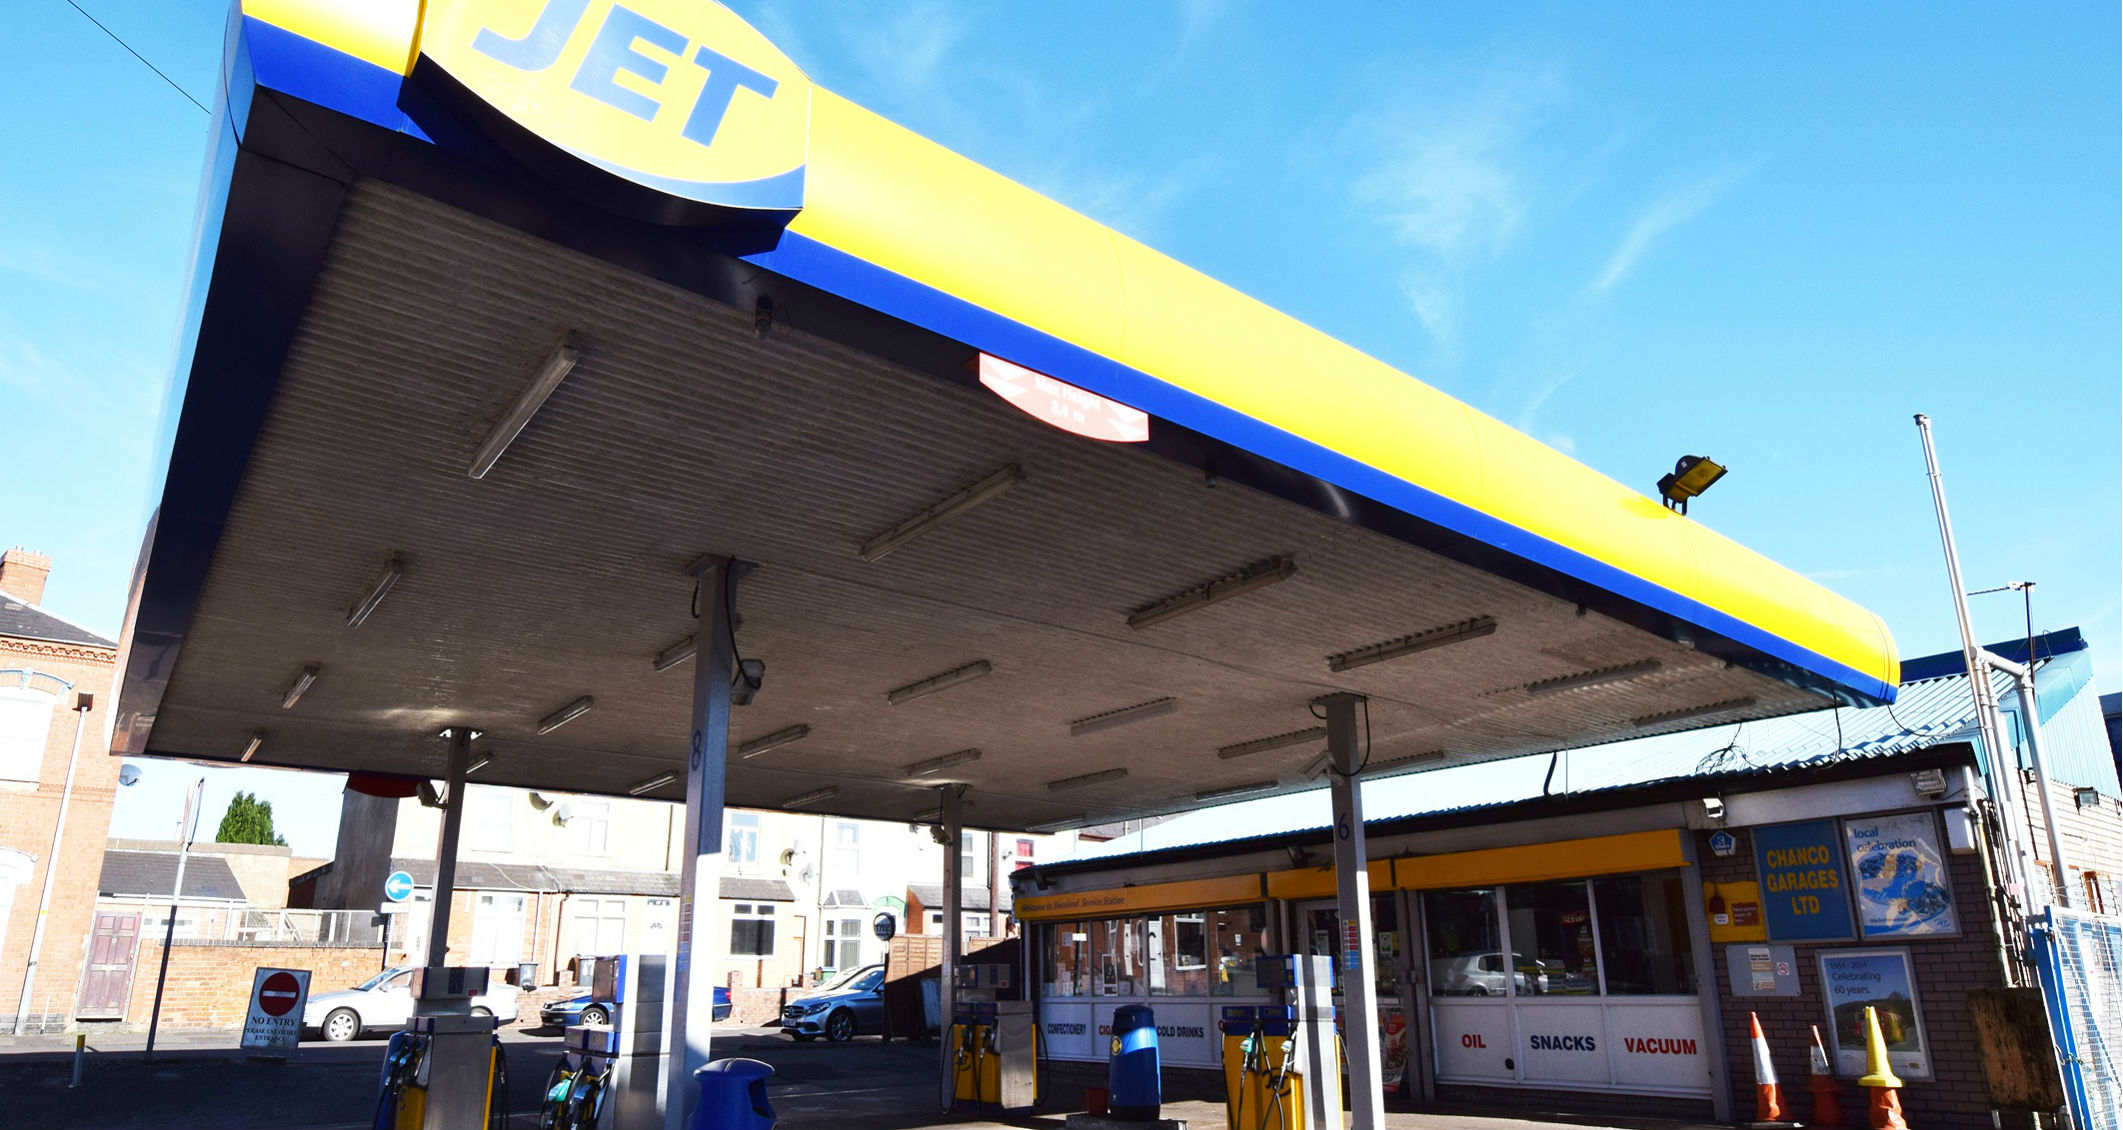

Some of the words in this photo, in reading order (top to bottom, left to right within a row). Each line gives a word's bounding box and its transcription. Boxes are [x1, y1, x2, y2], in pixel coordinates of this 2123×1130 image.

[471, 0, 780, 148] JET
[1035, 376, 1060, 395] Max
[1062, 386, 1101, 412] Height
[691, 729, 702, 772] 8
[1337, 812, 1351, 841] 6
[1853, 827, 1879, 839] local
[1856, 838, 1917, 853] celebration
[1766, 844, 1830, 868] CHANCO
[1766, 868, 1839, 893] GARAGES
[1081, 898, 1102, 907] Service
[1103, 895, 1125, 905] Station
[1791, 895, 1821, 916] LTD
[1832, 971, 1882, 982] Celebrating
[1834, 985, 1845, 994] 60
[251, 1016, 265, 1025] NO
[266, 1017, 296, 1026] ENTRY
[1047, 1023, 1087, 1035] CONFECTIONERY
[1157, 1025, 1176, 1037] COLD
[1176, 1026, 1205, 1039] DRINKS
[1461, 1034, 1487, 1049] OIL
[1530, 1034, 1597, 1051] SNACKS
[1623, 1037, 1698, 1056] VACUUM
